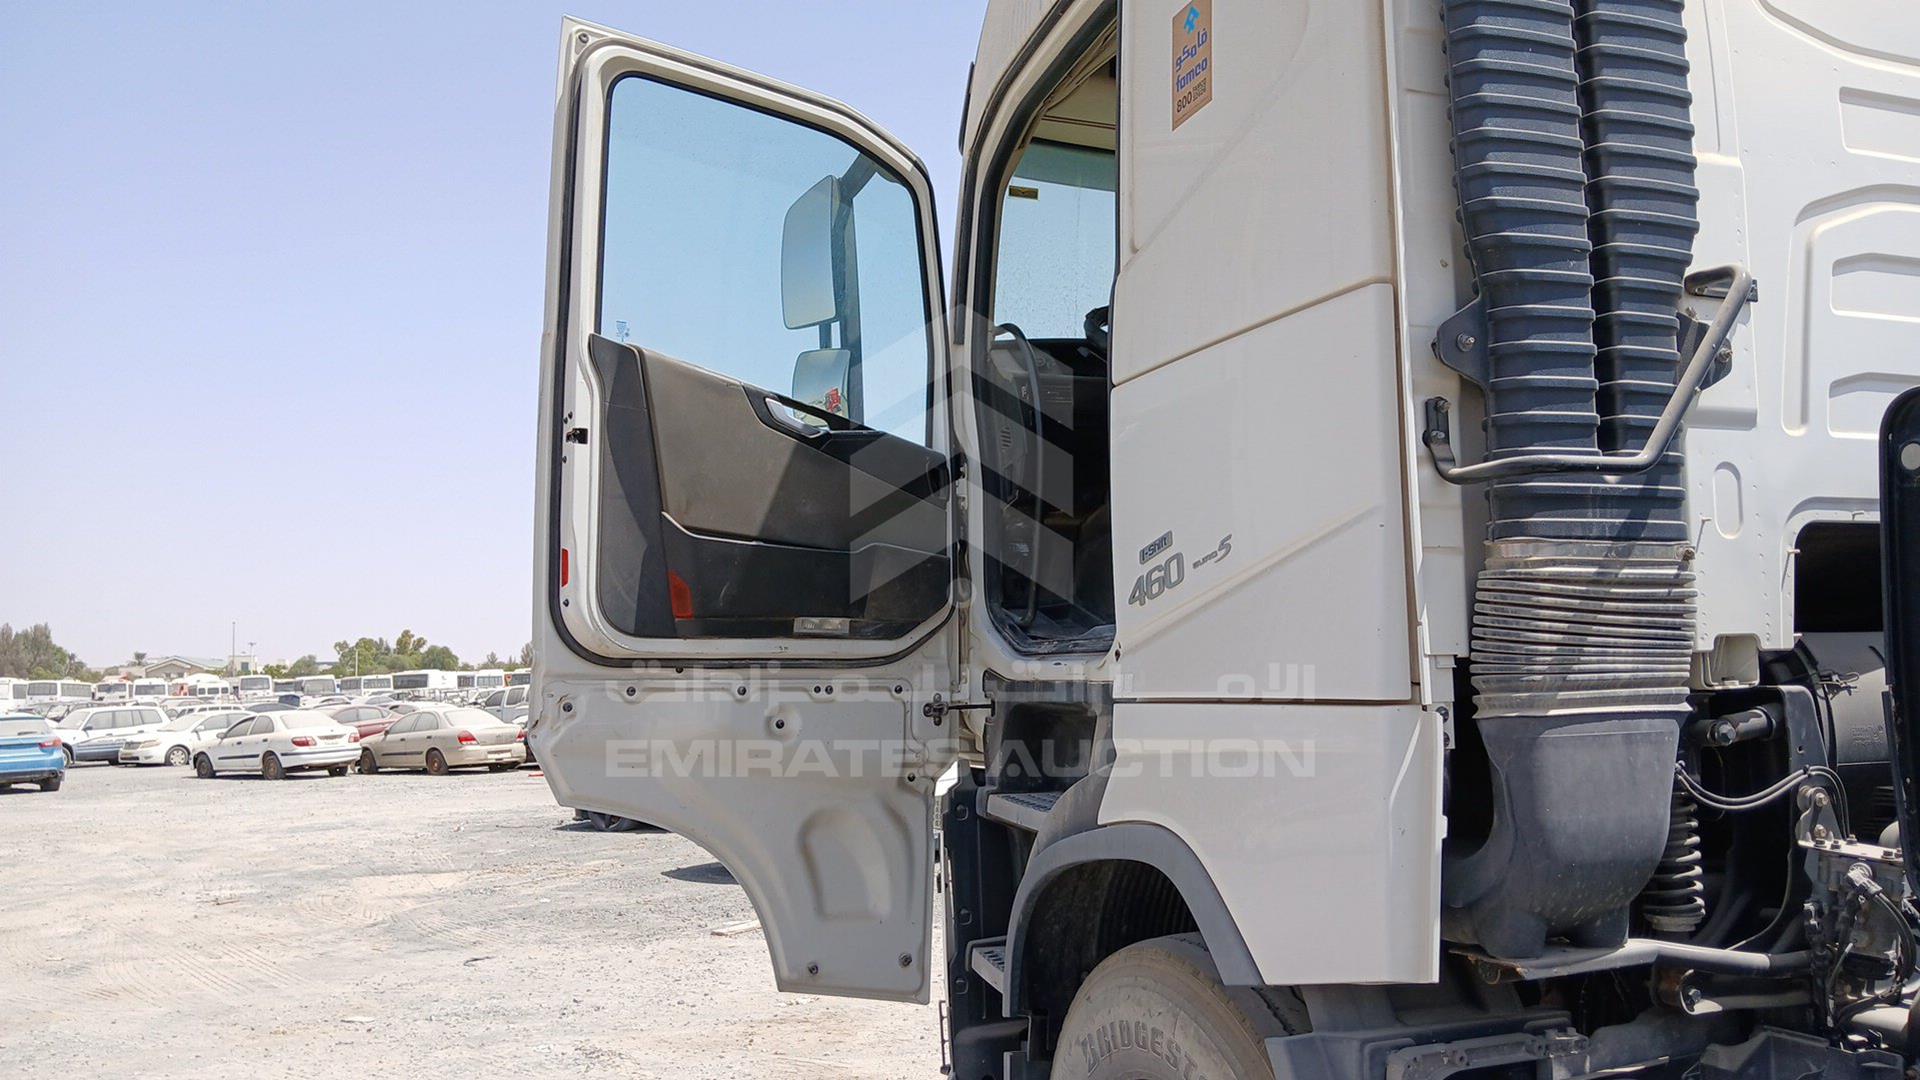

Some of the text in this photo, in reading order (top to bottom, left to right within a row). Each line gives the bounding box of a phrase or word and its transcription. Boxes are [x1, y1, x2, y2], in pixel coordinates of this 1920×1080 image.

[1176, 91, 1193, 113] 800
[1128, 551, 1185, 606] 460
[1081, 1019, 1208, 1080] BRIDGEST
